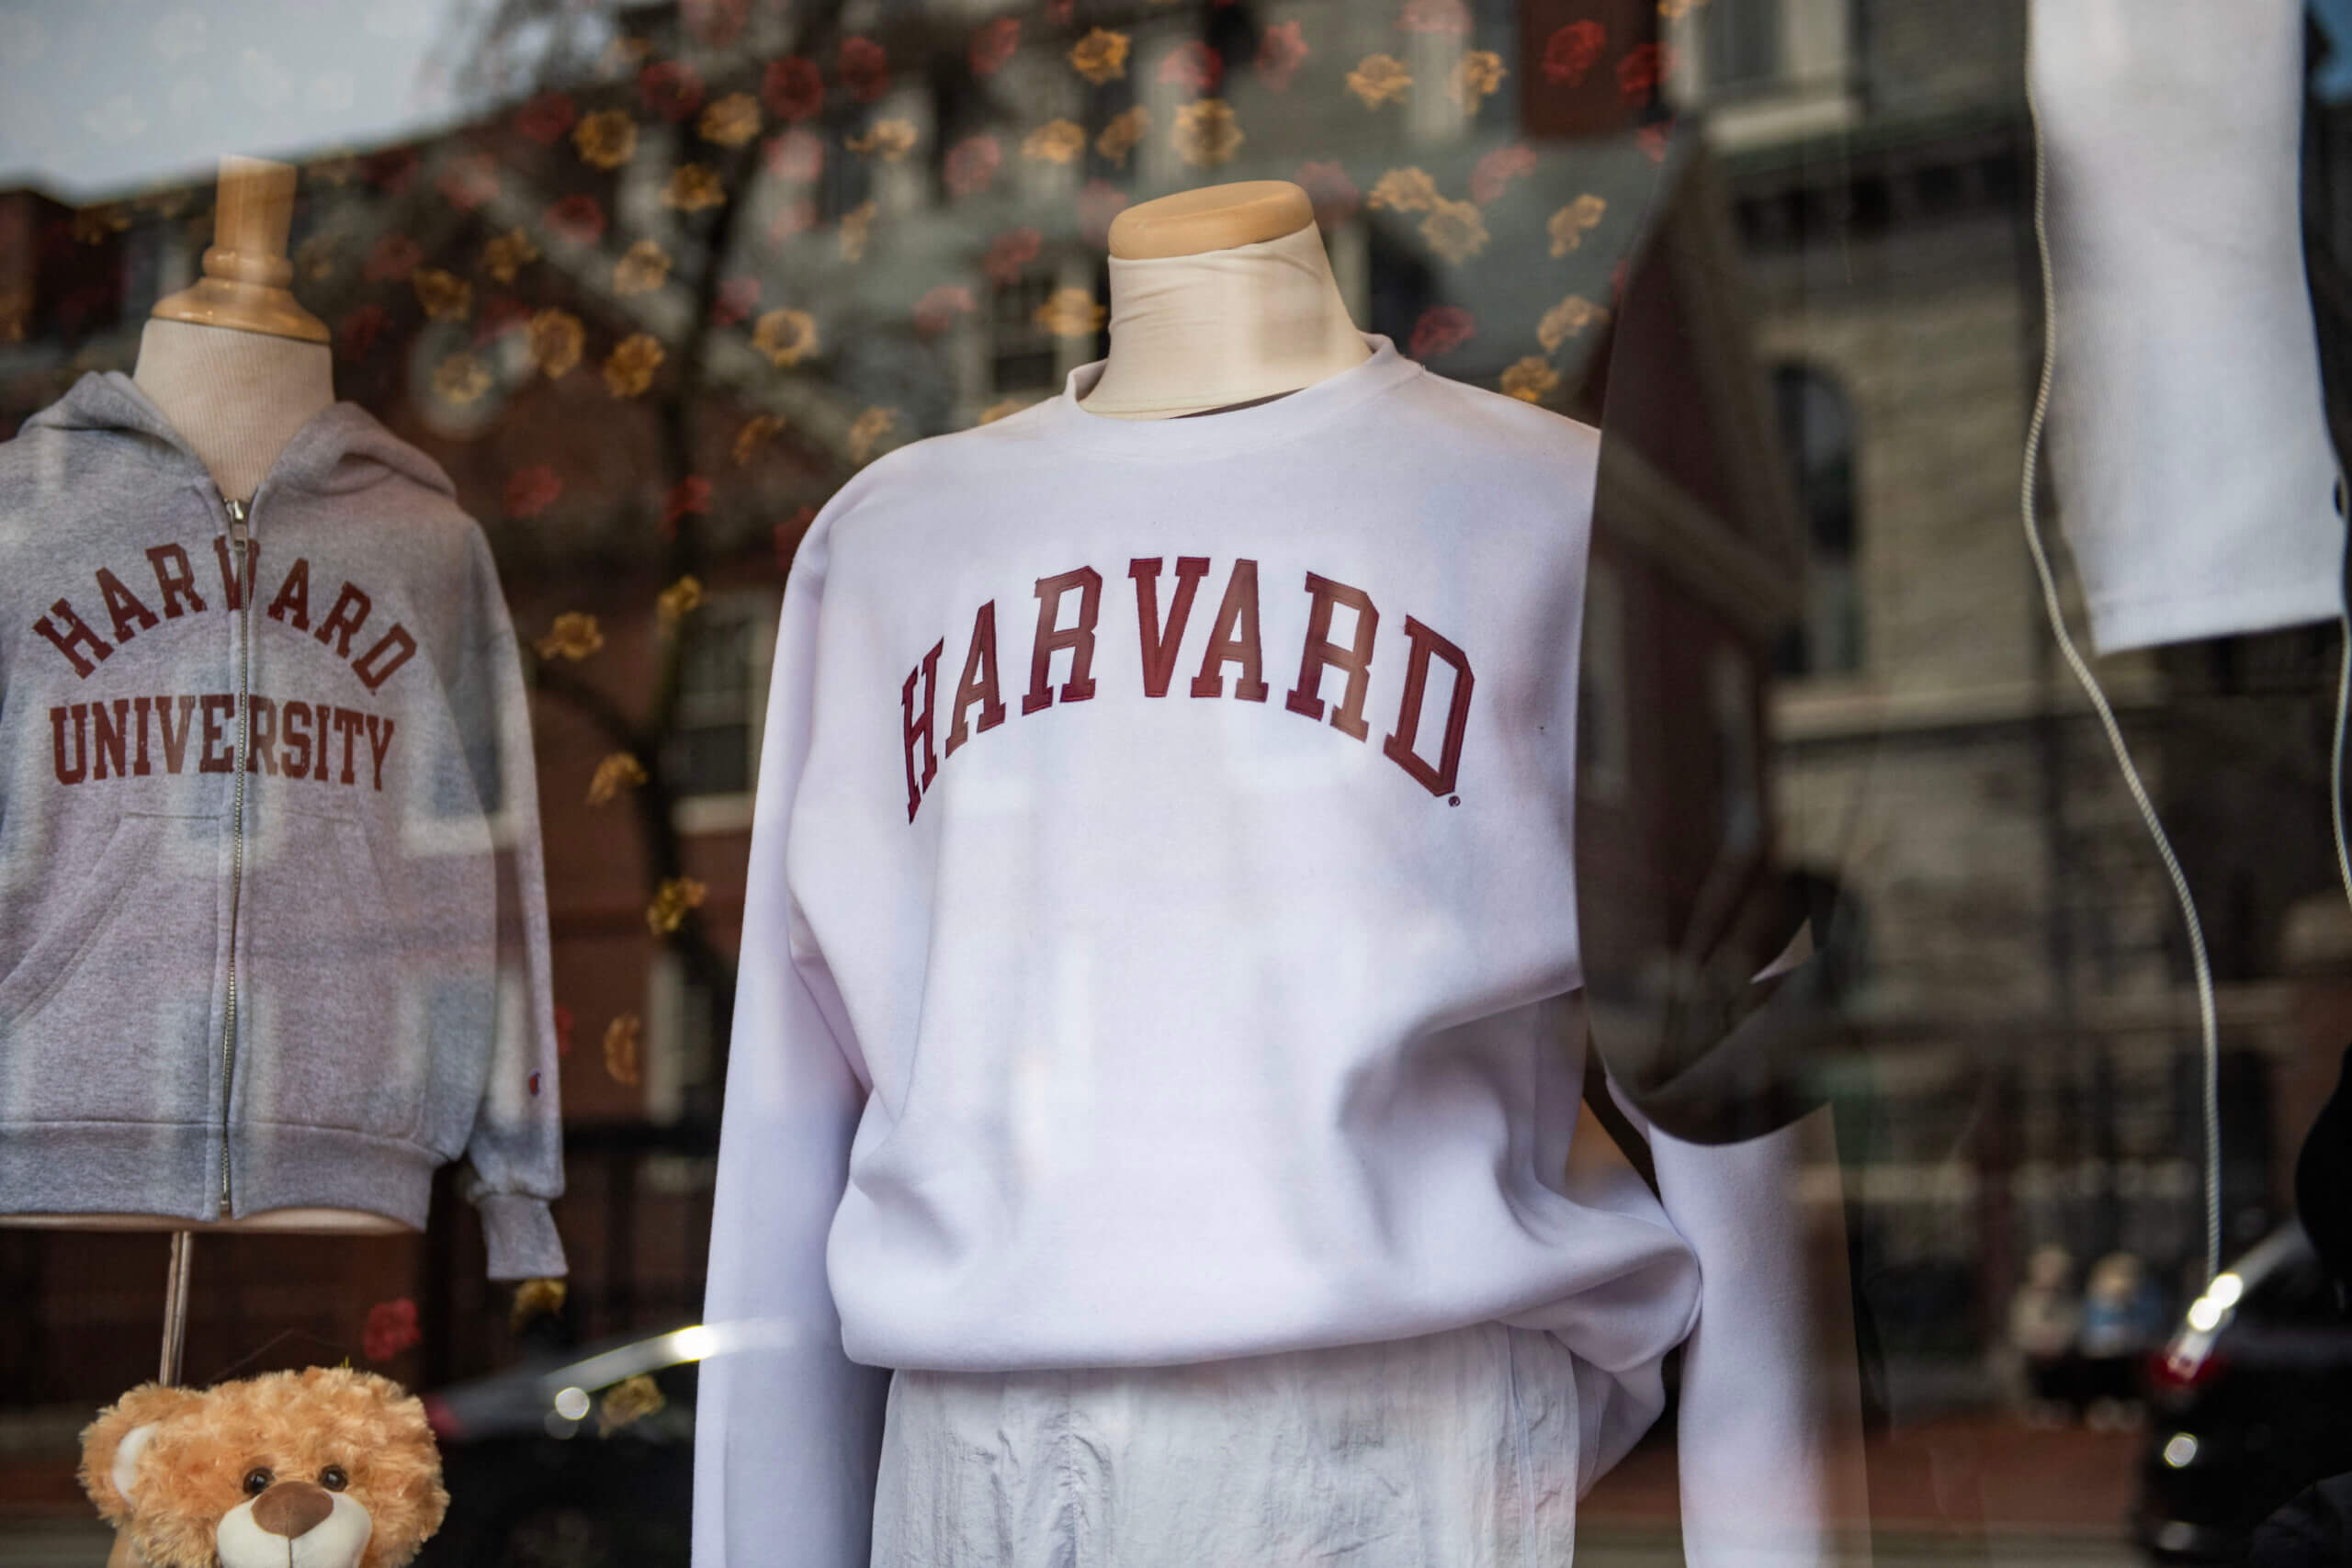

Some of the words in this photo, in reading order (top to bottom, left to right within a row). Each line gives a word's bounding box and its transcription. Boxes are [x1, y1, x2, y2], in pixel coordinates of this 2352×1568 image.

[32, 535, 417, 691] HARVARD
[901, 556, 1475, 825] HARVARD
[49, 694, 395, 792] UNIVERSITY
